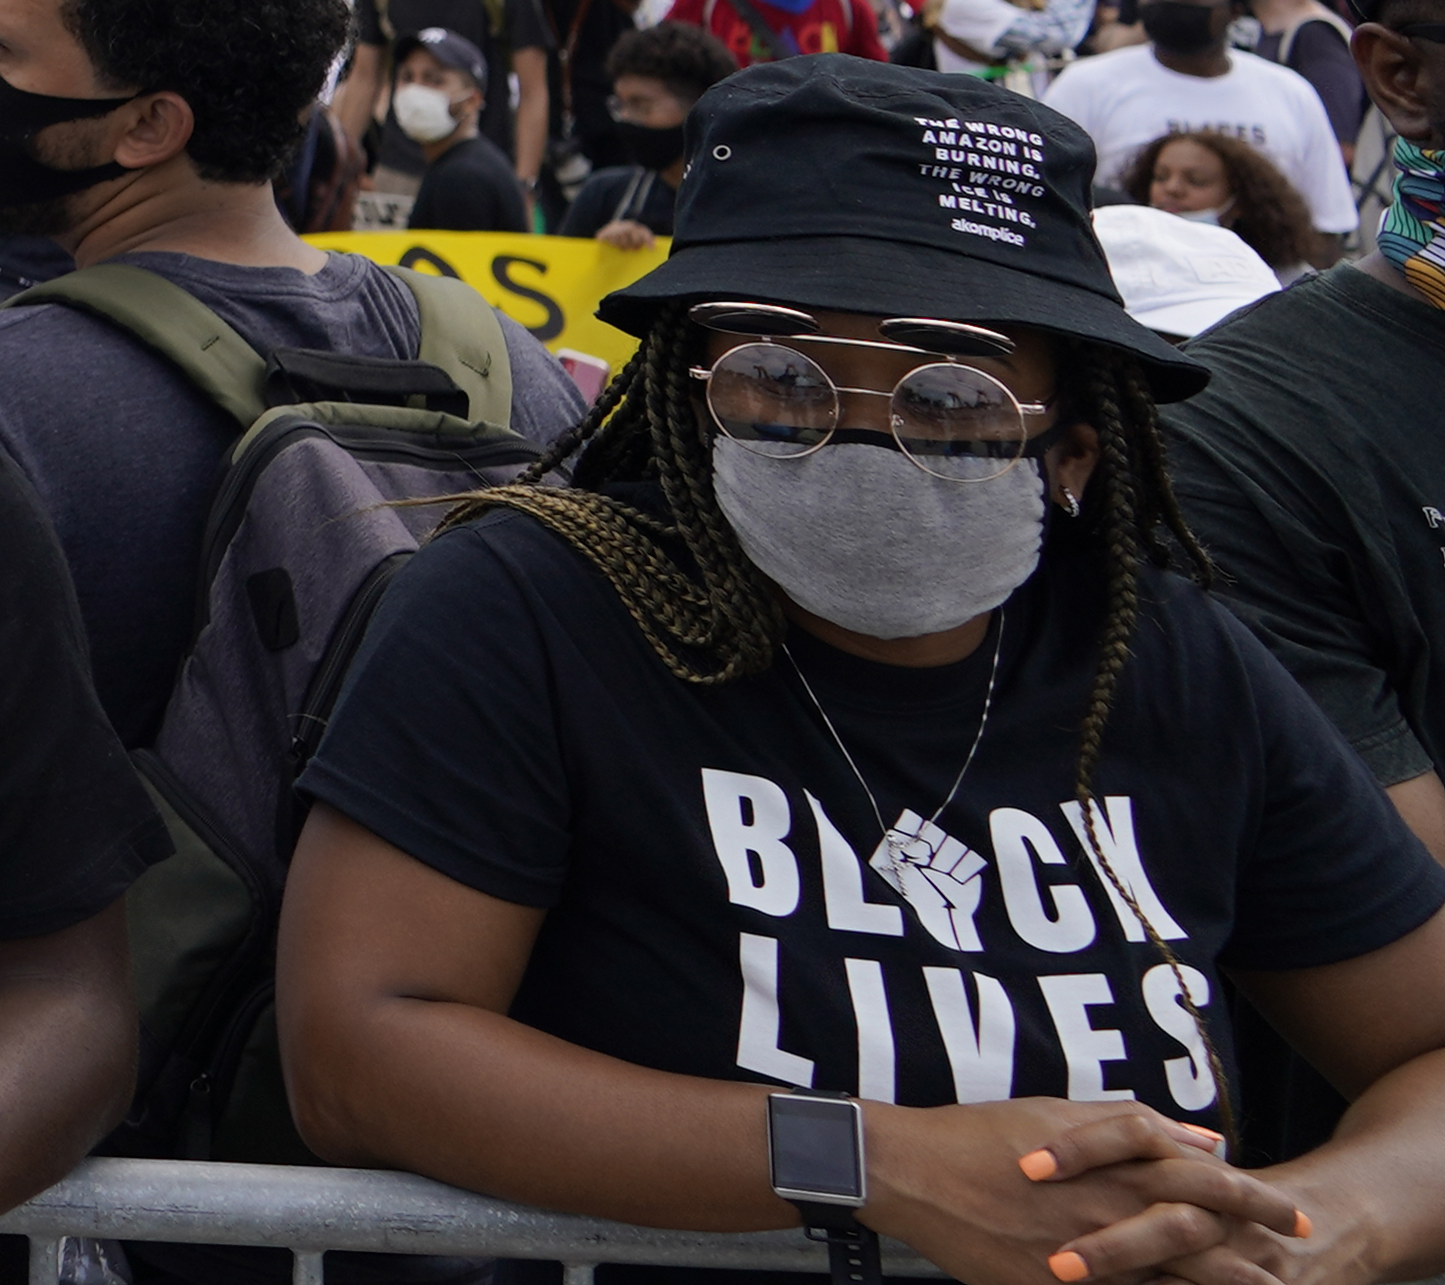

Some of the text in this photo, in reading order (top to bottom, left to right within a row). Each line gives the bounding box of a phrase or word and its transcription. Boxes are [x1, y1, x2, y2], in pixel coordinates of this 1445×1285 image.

[914, 117, 1044, 147] THE WRONG
[922, 130, 1044, 162] AMAZON IS
[935, 147, 1041, 180] BURNING.
[918, 163, 1045, 197] THE WRONG
[951, 182, 1014, 204] ICE IS
[938, 194, 1037, 229] MELTING.
[950, 218, 1026, 247] akomplice
[735, 931, 1224, 1113] LIVES
